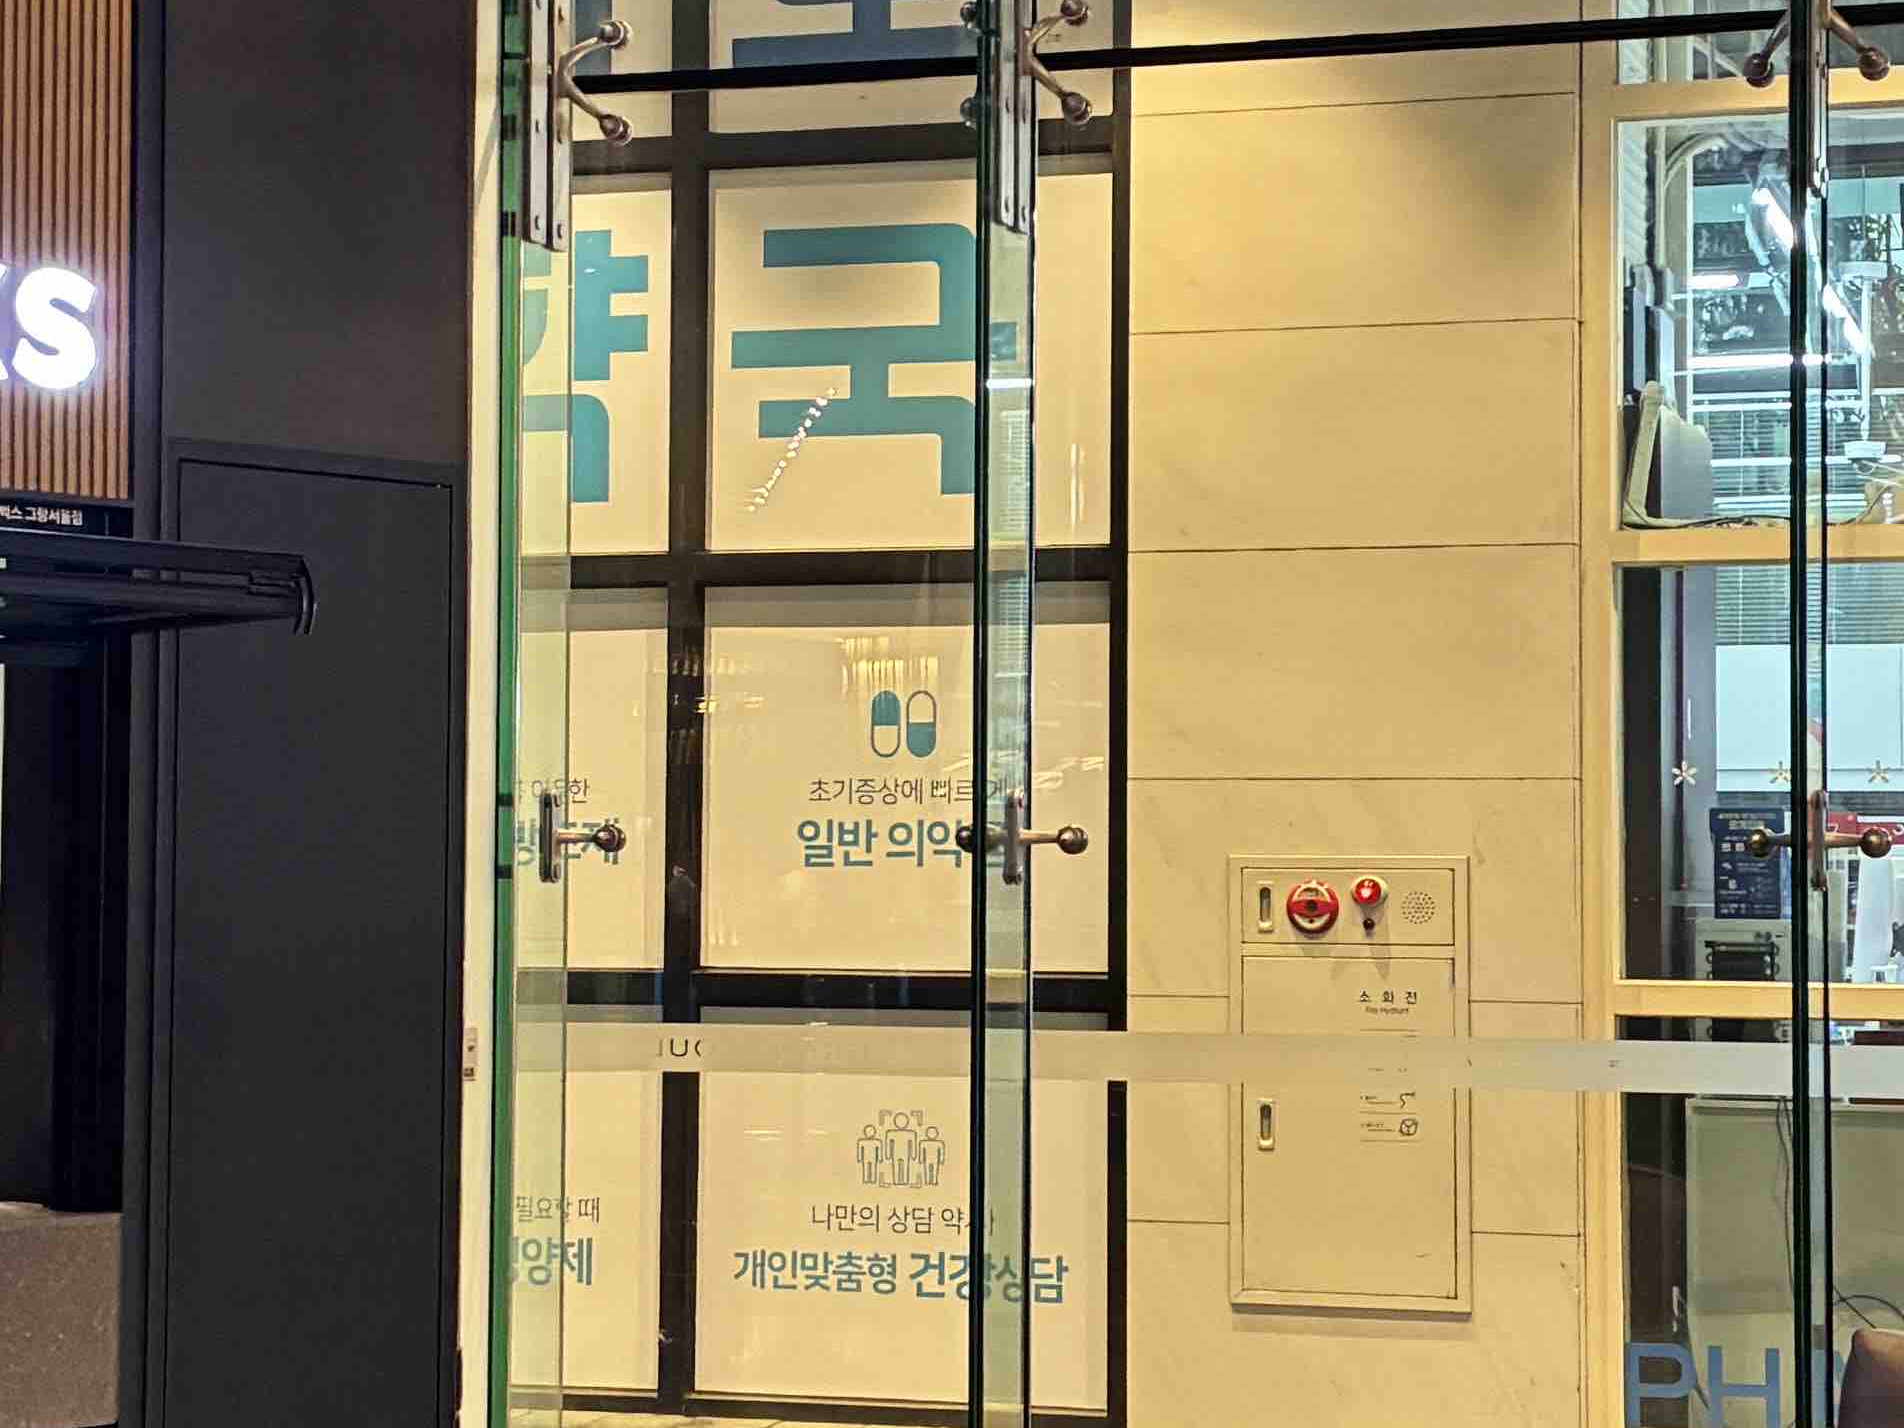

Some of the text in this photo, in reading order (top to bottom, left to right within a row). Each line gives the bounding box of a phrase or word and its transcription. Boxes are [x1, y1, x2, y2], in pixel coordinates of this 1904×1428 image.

[808, 777, 923, 805] 초기증상에
[797, 819, 1004, 869] 일반 의약
[577, 1197, 600, 1223] 때
[811, 1203, 881, 1233] 나만의
[887, 1205, 936, 1235] 상담
[733, 1249, 897, 1295] 개인맞춤형
